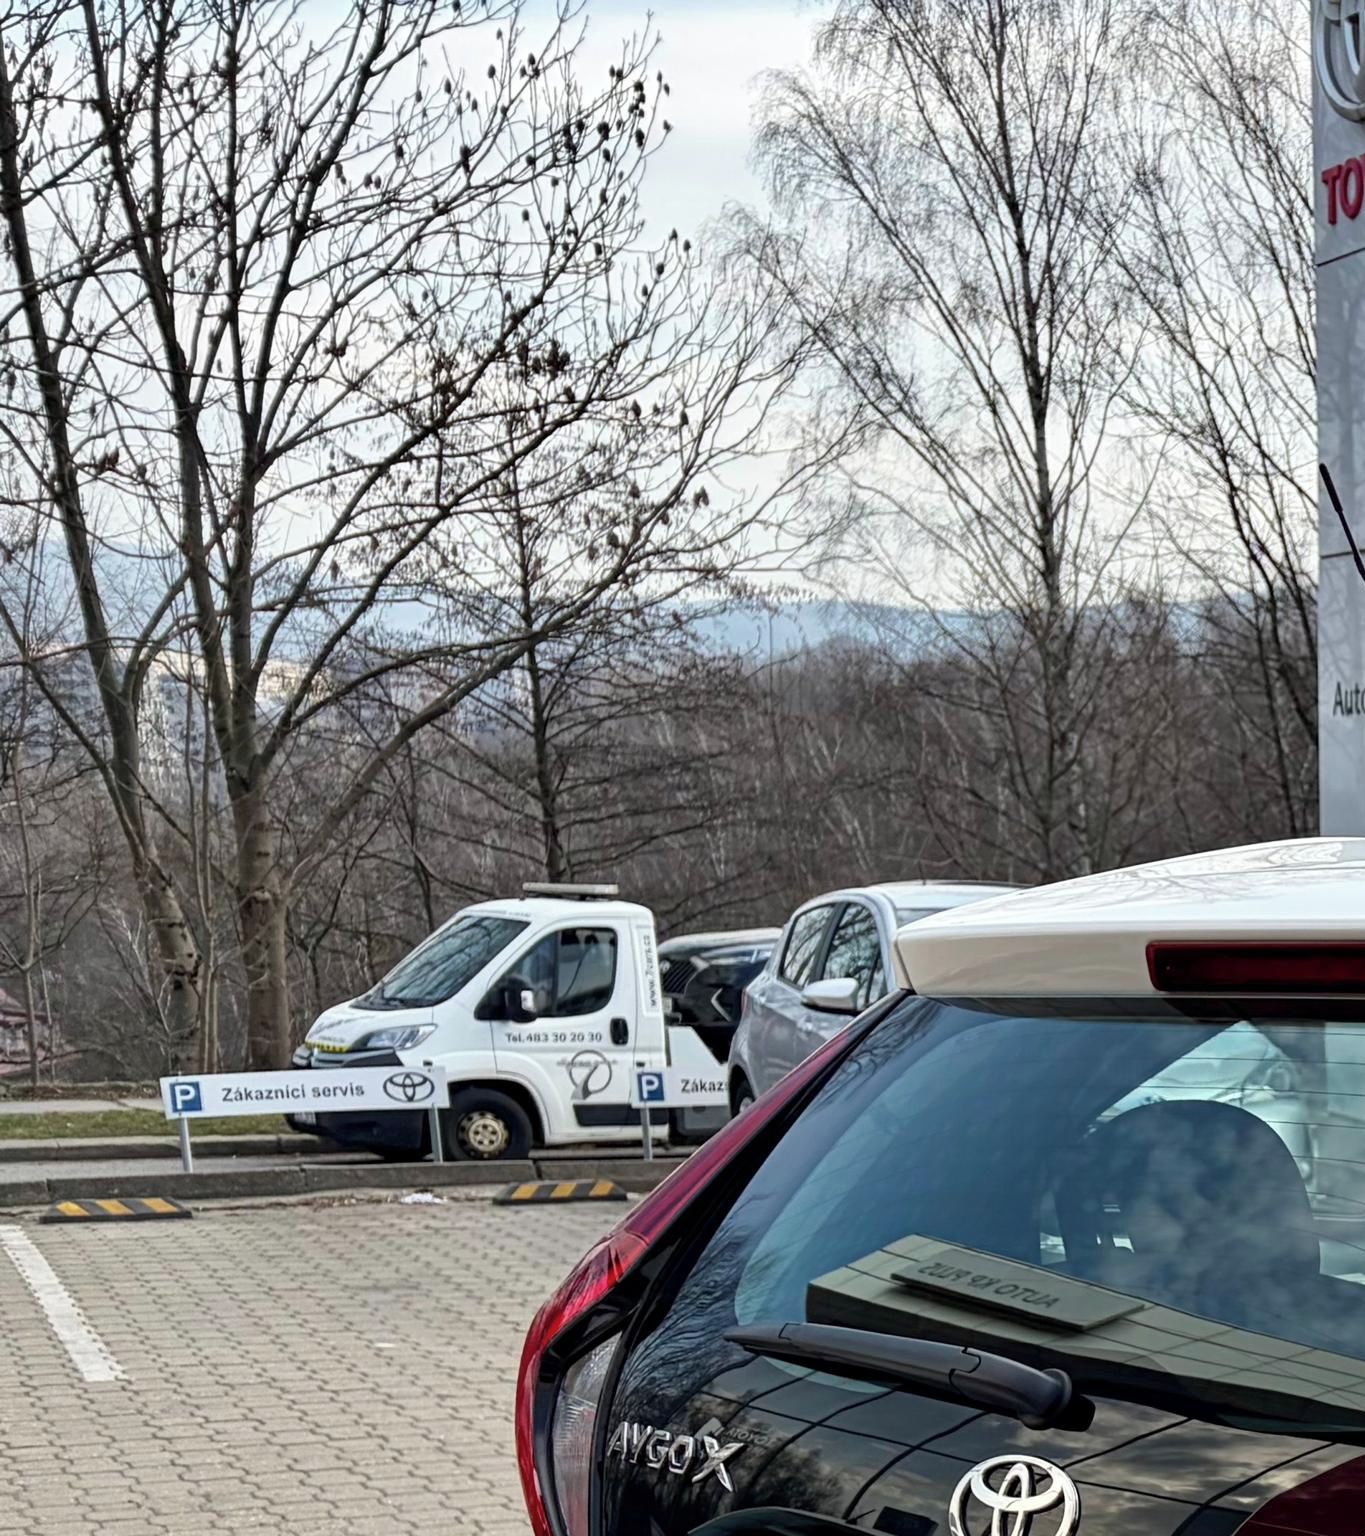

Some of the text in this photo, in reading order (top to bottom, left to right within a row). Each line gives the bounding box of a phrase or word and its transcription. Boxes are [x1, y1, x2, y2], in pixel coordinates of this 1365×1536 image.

[551, 1032, 567, 1043] 30
[570, 1032, 585, 1043] 20
[588, 1032, 603, 1043] 30
[174, 1082, 365, 1110] P Zákazníci servis
[641, 1074, 659, 1100] P
[607, 1421, 746, 1492] AYGO X
